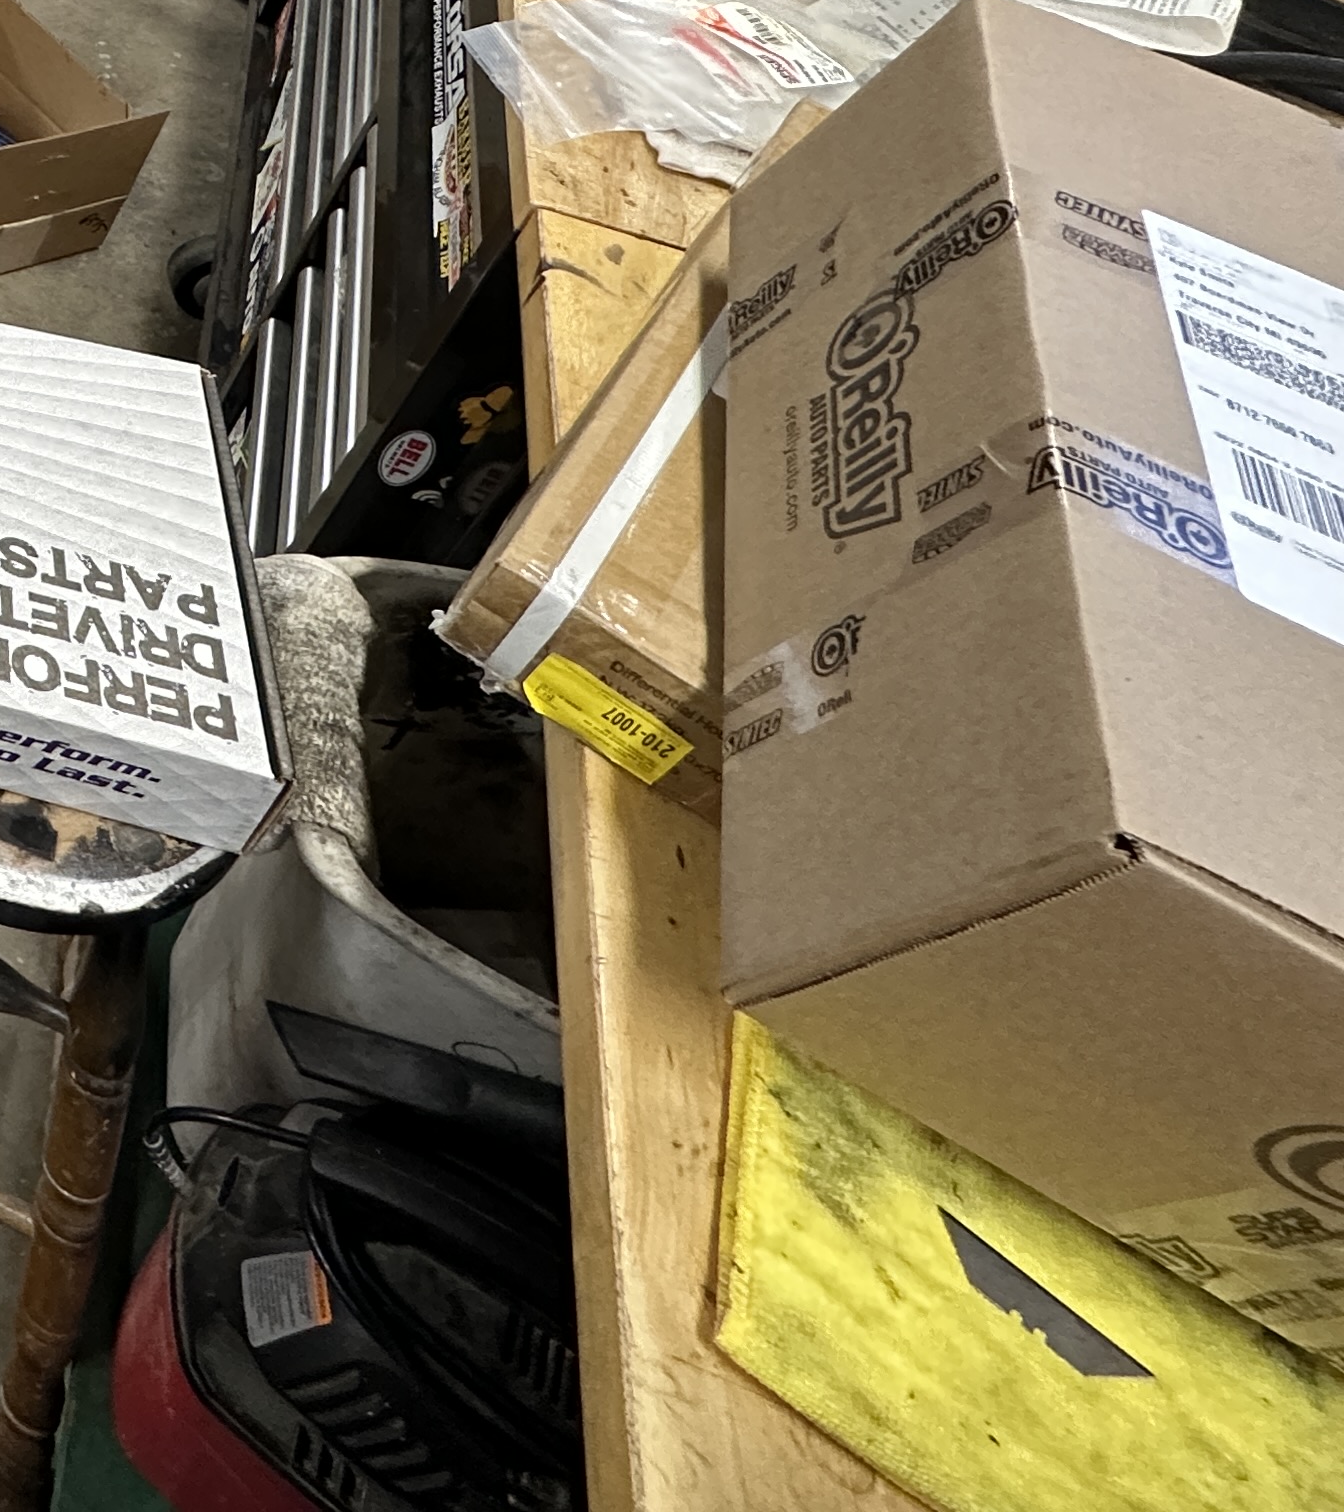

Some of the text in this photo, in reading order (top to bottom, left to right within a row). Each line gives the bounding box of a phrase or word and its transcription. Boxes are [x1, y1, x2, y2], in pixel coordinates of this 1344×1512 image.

[433, 69, 445, 126] EXHAUSTS
[1055, 190, 1150, 242] SYNTEC
[825, 289, 921, 540] O'Reilly
[387, 438, 429, 476] BELL
[785, 405, 802, 532] oreillyauto.com
[809, 393, 831, 507] AUTO PARTS
[1027, 444, 1234, 570] O'Reilly
[1115, 472, 1170, 501] AUTO
[610, 659, 696, 718] Differential
[600, 705, 677, 760] 210-1007
[32, 755, 147, 800] Last.
